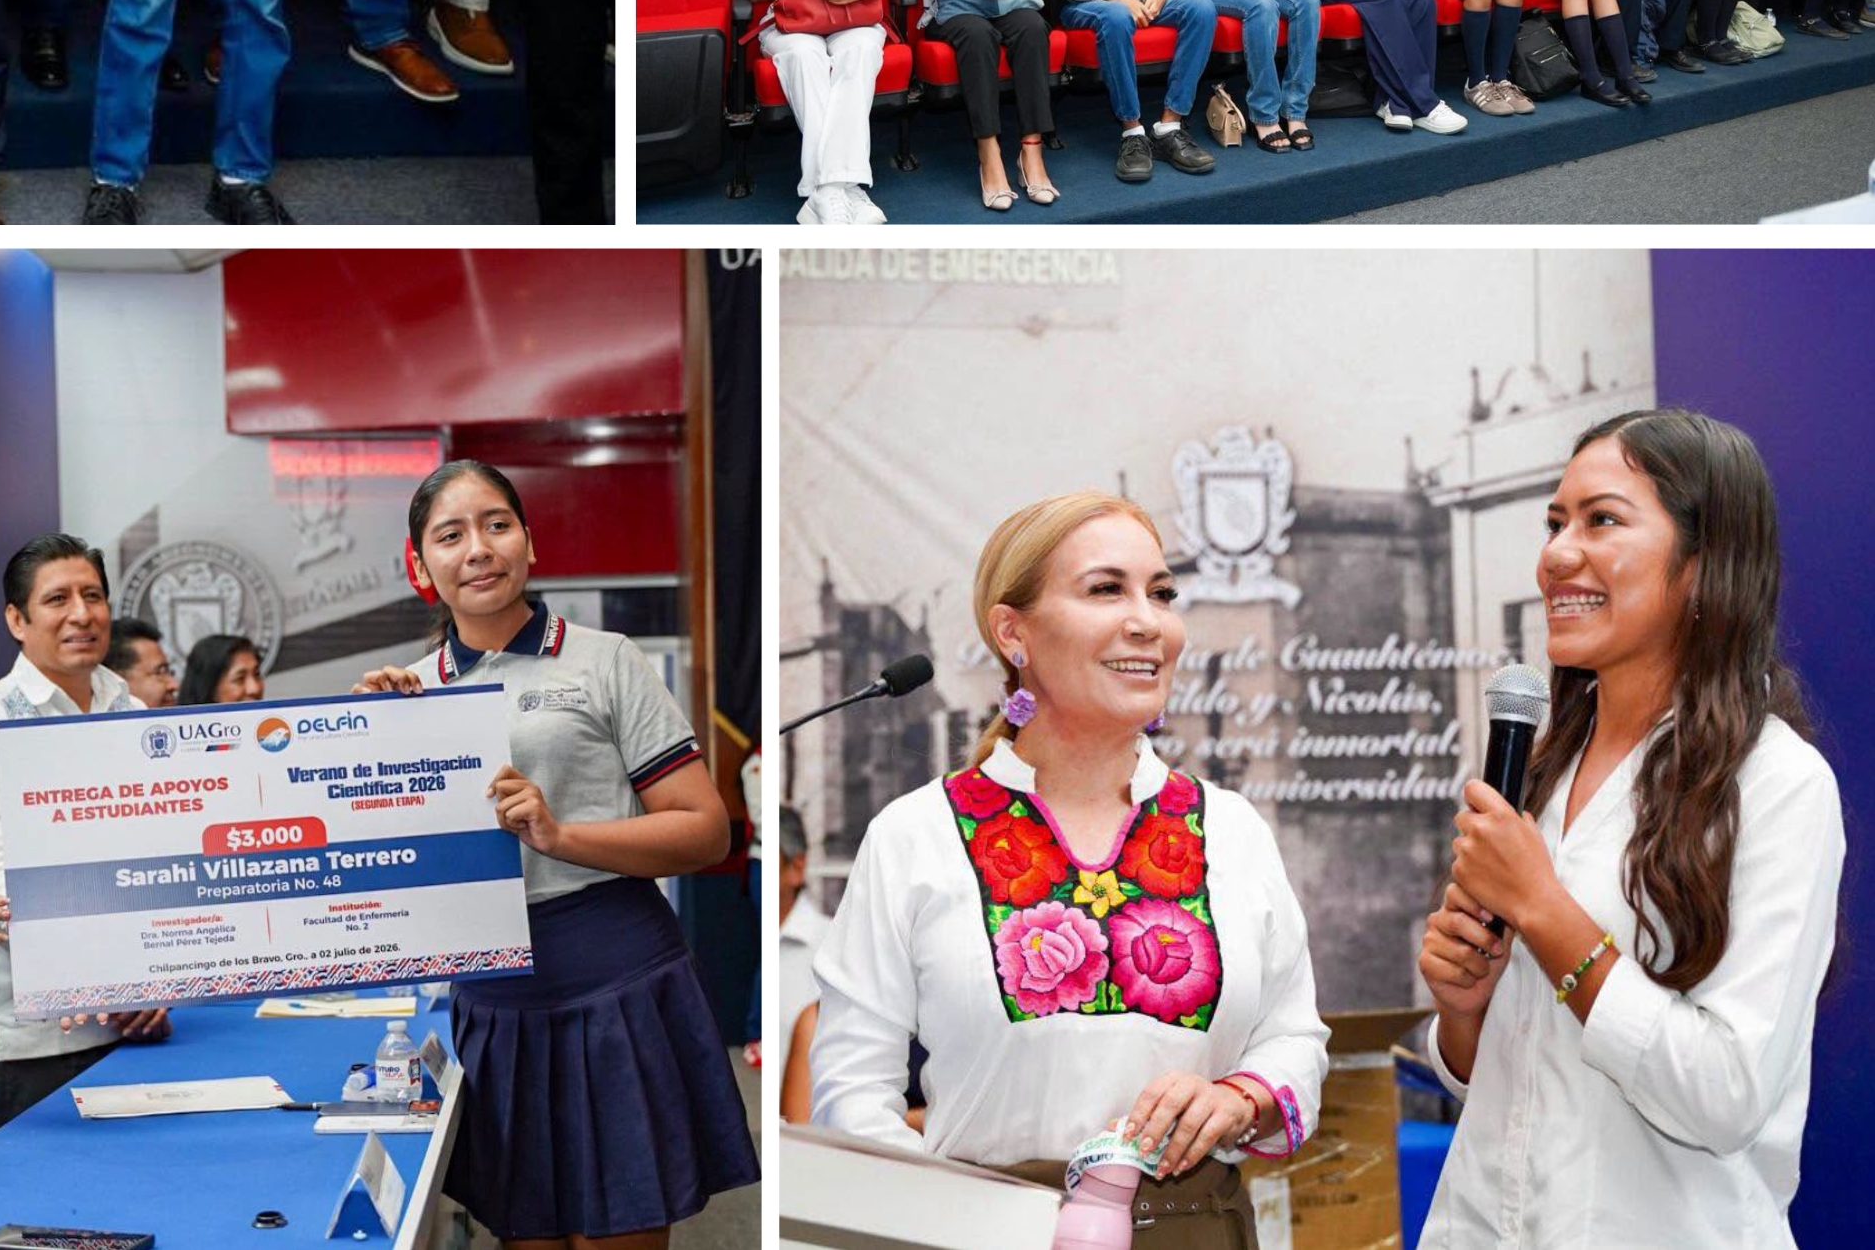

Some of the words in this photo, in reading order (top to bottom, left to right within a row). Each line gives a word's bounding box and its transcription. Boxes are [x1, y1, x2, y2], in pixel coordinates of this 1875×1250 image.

[179, 721, 241, 741] UAGro
[287, 766, 348, 783] Verano
[352, 763, 372, 778] de
[377, 754, 482, 776] Investigación
[22, 786, 114, 806] ENTREGA
[118, 783, 144, 798] DE
[150, 776, 229, 796] APOYOS
[327, 780, 403, 799] Científica
[408, 774, 446, 793] 2026
[52, 808, 66, 823] A
[71, 797, 204, 821] ESTUDIANTES
[351, 797, 394, 811] (SEGUNDA
[395, 794, 425, 807] ETAPA)
[226, 825, 303, 851] $3,000
[112, 860, 196, 888] Sarahi
[202, 856, 320, 880] Villazana
[325, 848, 416, 870] Terrero
[196, 878, 290, 899] Preparatoria
[294, 877, 319, 890] No.
[322, 874, 341, 887] 48
[328, 901, 382, 912] Institución:
[151, 914, 223, 927] Investigador/a:
[303, 914, 343, 926] Facultad
[344, 914, 357, 922] de
[345, 923, 361, 932] No.
[362, 922, 369, 930] 2
[140, 931, 159, 940] Dra.
[161, 929, 193, 937] Norma
[195, 924, 236, 936] Angélica
[143, 939, 174, 949] Bernal
[175, 938, 202, 946] Pérez
[204, 934, 235, 945] Tejeda
[149, 961, 217, 973] Chilpancingo
[219, 958, 232, 967] de
[234, 957, 249, 966] los
[251, 955, 283, 965] Bravo,
[318, 949, 331, 958] 02
[333, 947, 357, 959] julio
[358, 945, 371, 955] de
[373, 942, 401, 953] 2026.
